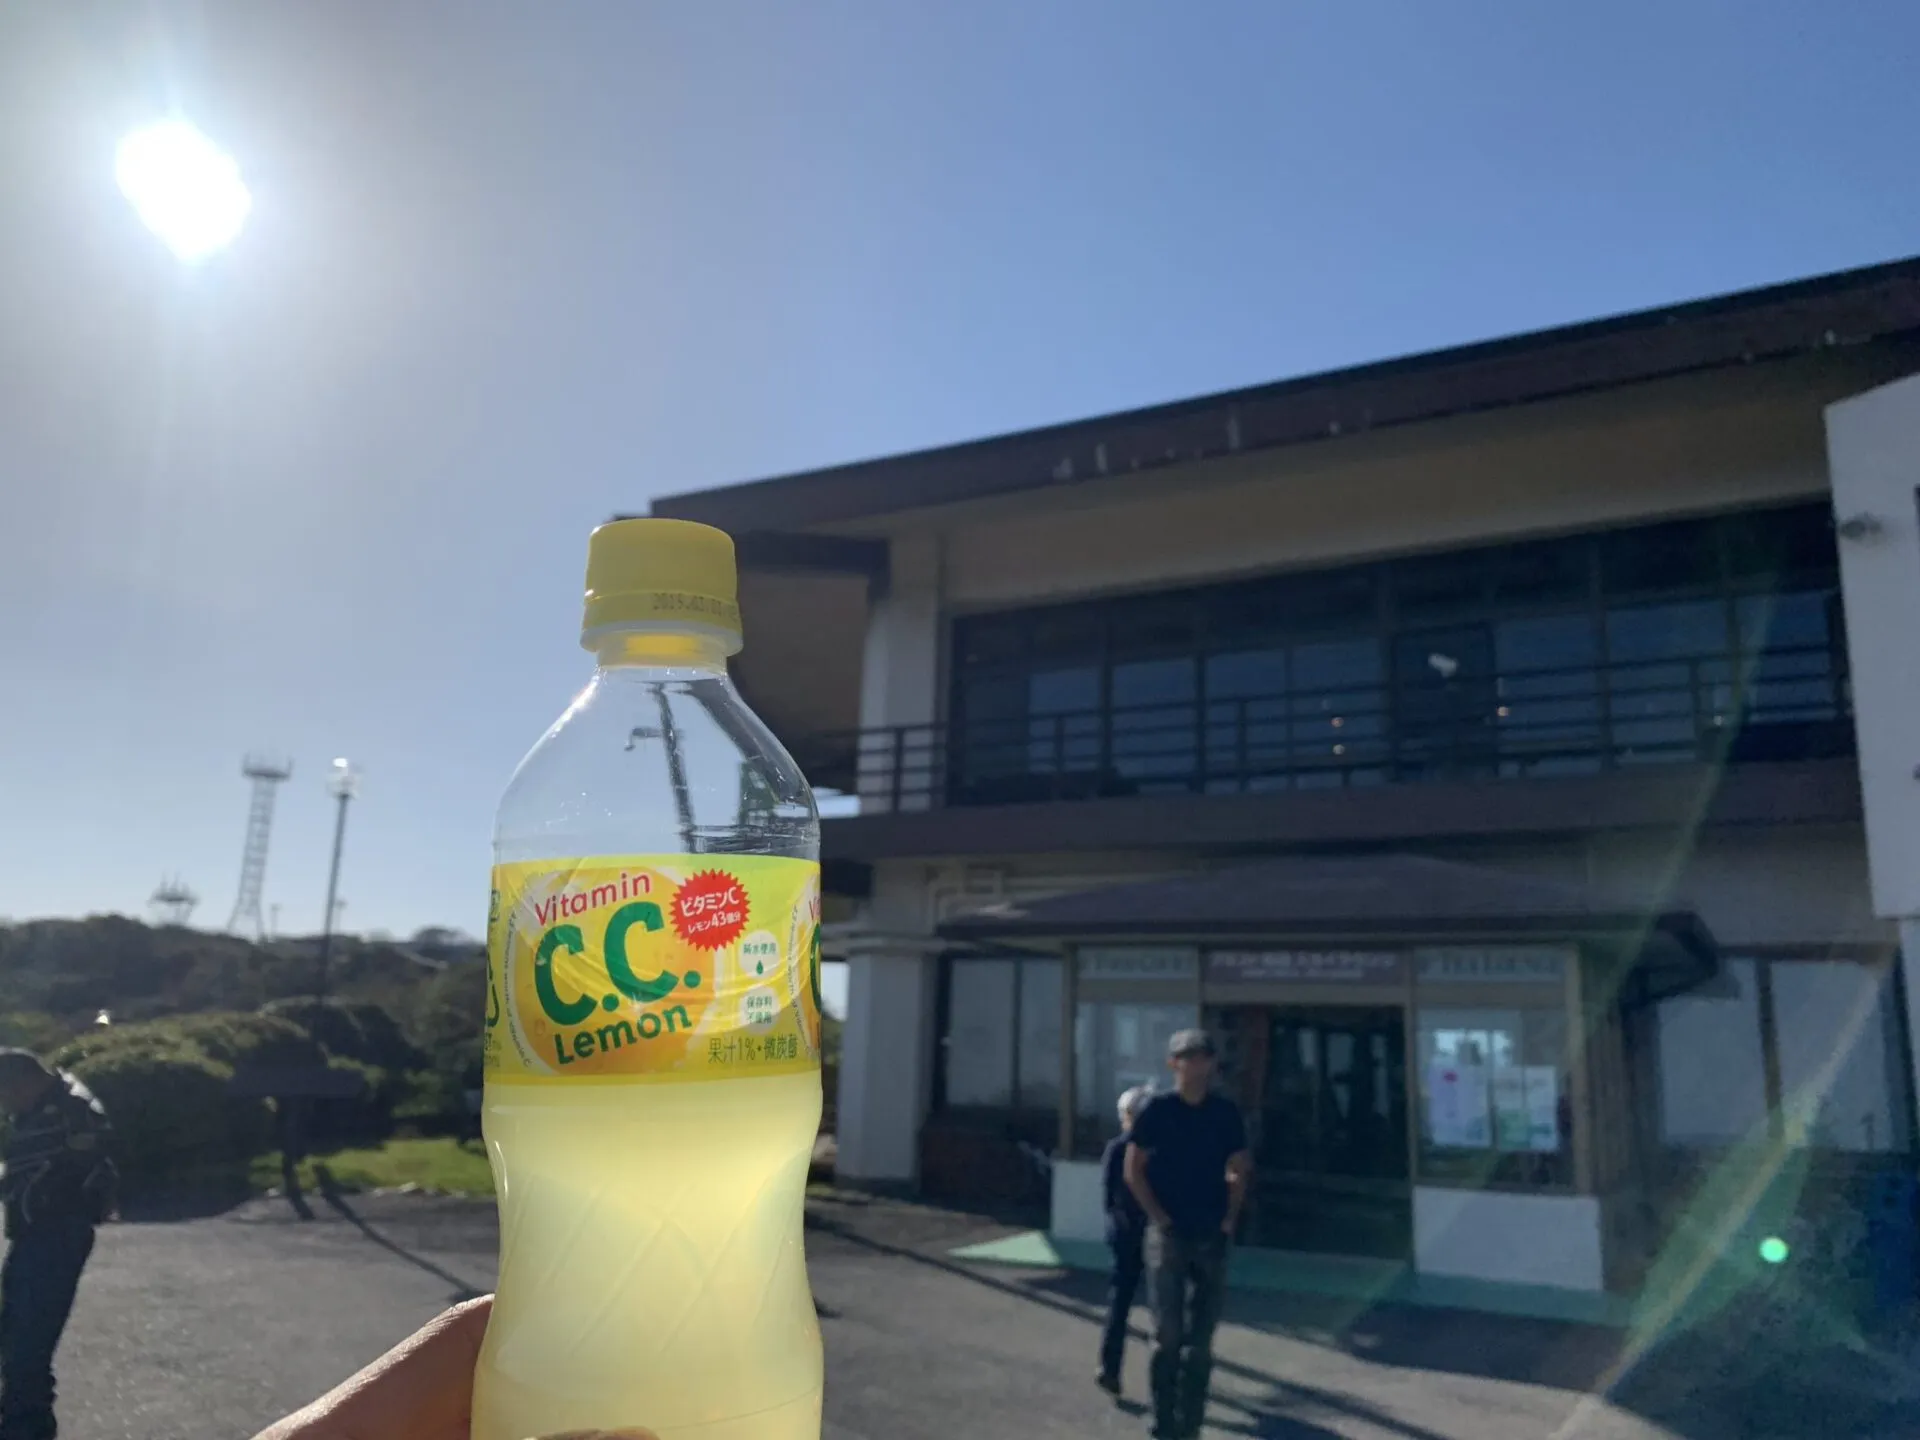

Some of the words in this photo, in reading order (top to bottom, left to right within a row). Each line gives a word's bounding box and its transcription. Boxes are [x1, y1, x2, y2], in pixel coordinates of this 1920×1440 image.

[534, 872, 651, 926] Vitamin
[680, 886, 740, 918] ビタミンC
[534, 901, 701, 1025] C.C.
[553, 1003, 692, 1064] Lemon
